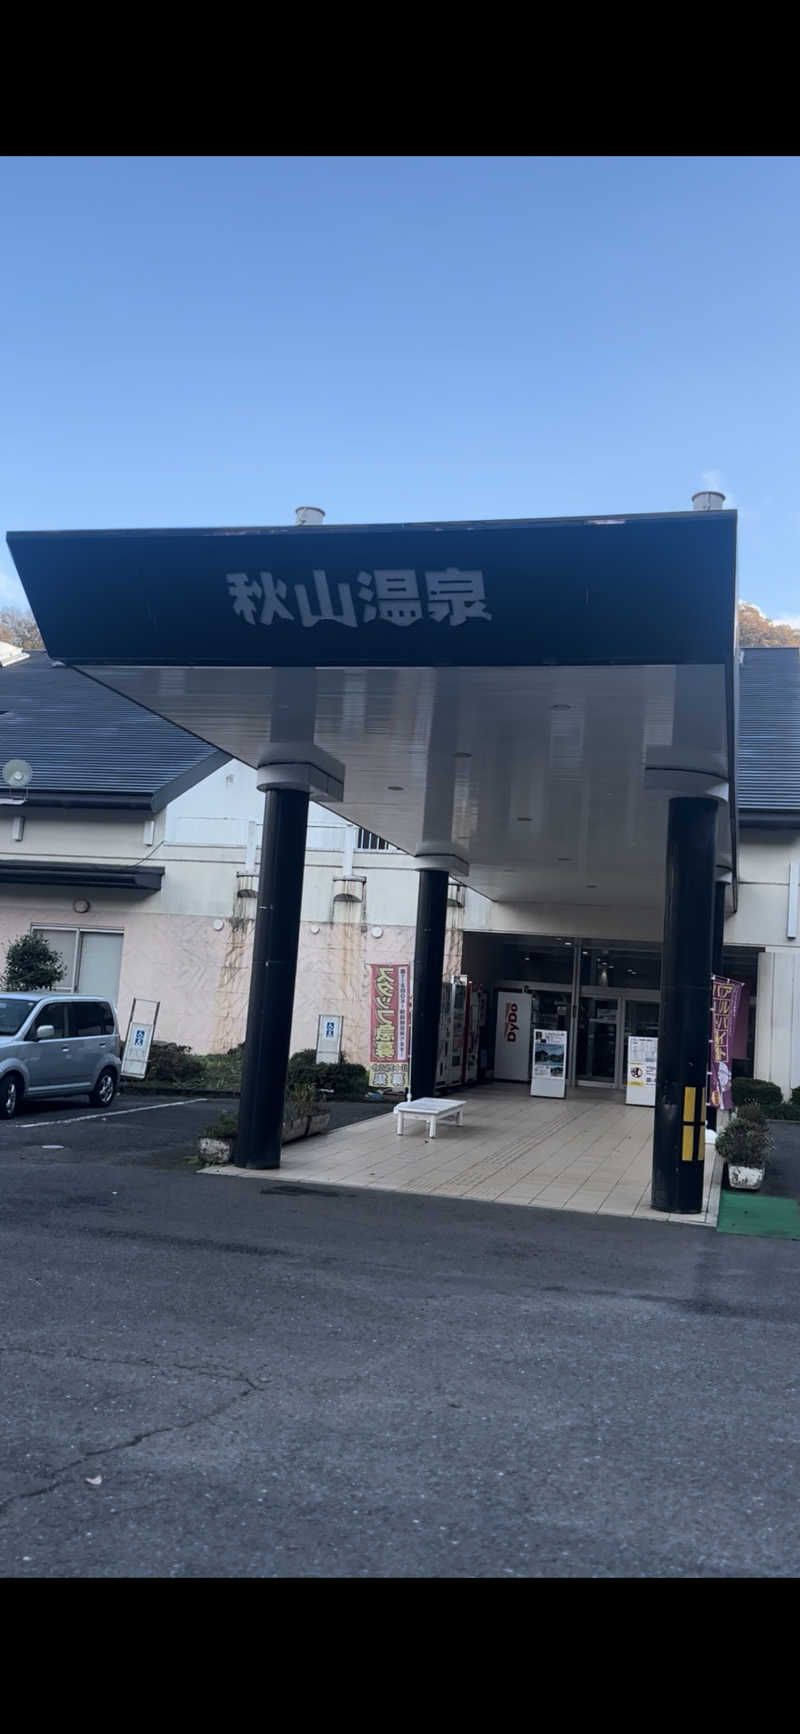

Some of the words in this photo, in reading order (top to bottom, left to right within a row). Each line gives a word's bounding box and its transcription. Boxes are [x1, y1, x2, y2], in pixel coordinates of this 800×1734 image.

[226, 567, 492, 627] 秋山温泉
[506, 1003, 519, 1042] DyDo
